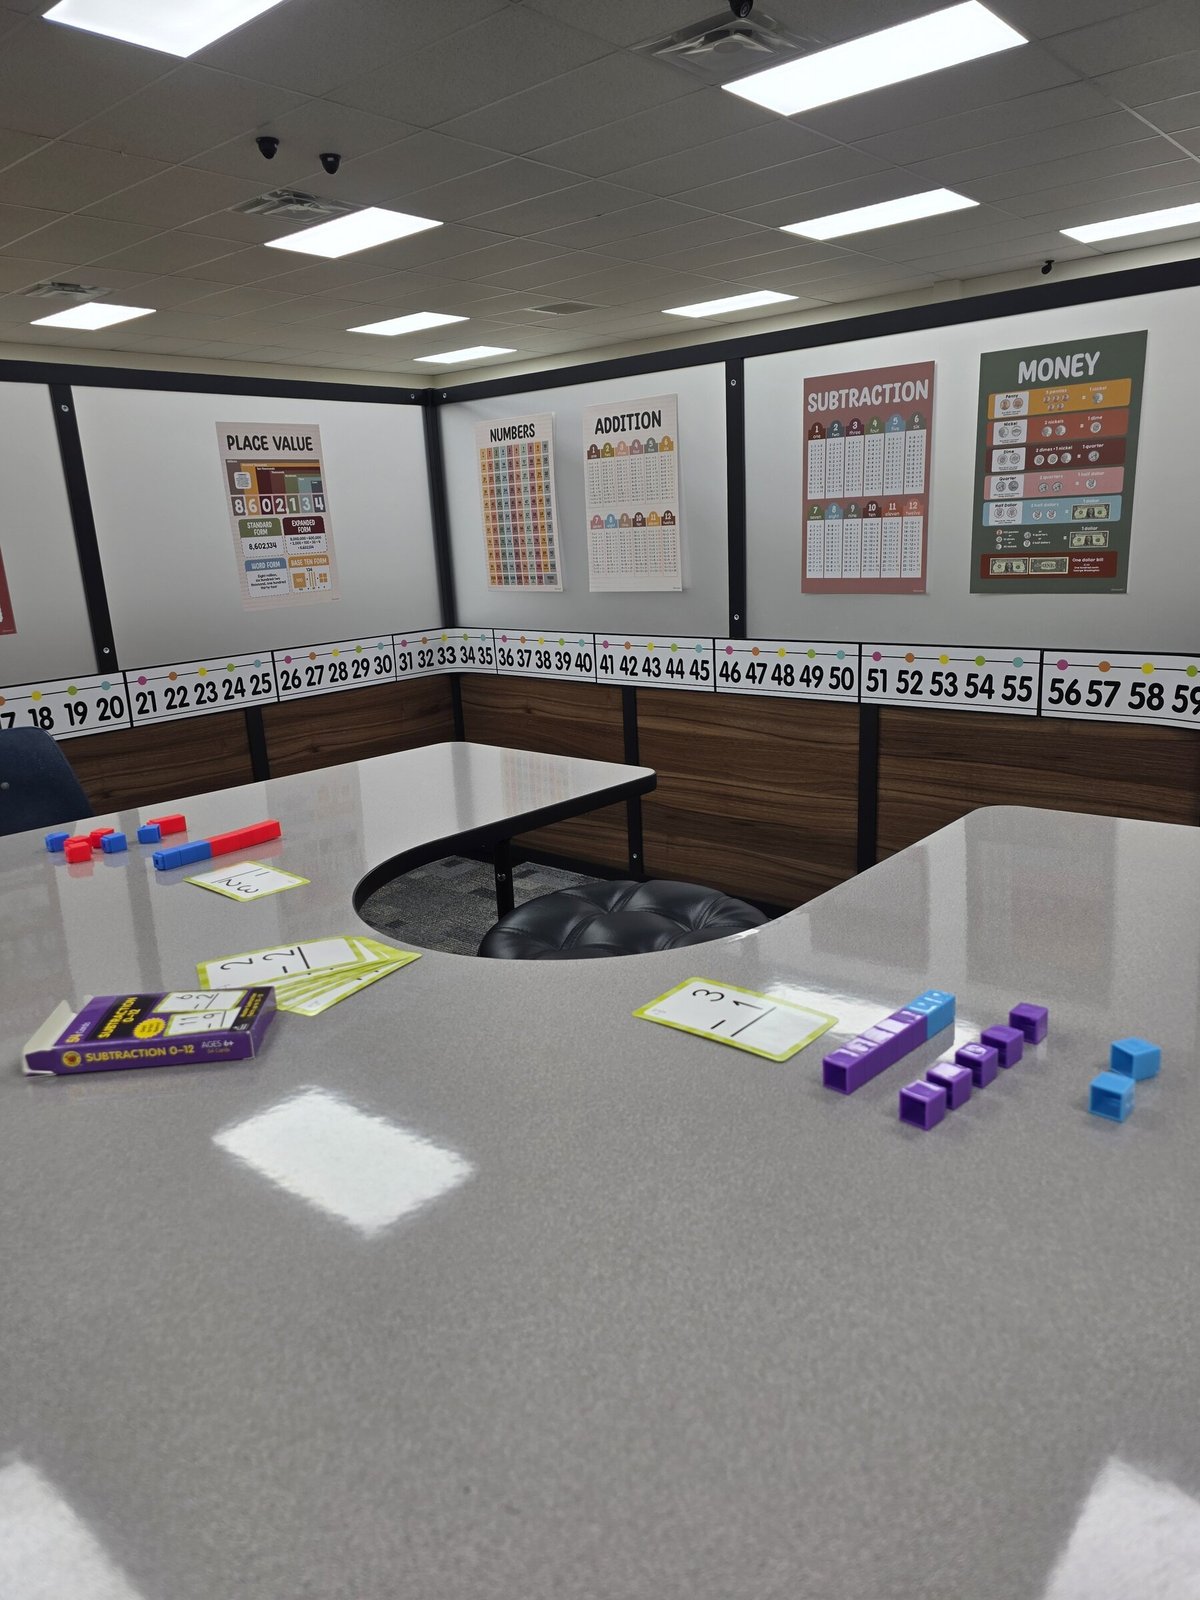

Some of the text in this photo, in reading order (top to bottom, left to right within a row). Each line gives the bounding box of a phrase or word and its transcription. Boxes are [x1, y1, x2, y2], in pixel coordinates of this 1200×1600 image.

[1017, 351, 1100, 384] MONEY
[807, 379, 929, 413] SUBTRACTION
[594, 410, 662, 435] ADDITION
[893, 417, 898, 425] 5
[914, 414, 919, 423] 6
[833, 423, 839, 431] 2
[852, 421, 858, 430] 3
[872, 419, 878, 428] 4
[489, 423, 535, 443] NUMBERS
[814, 425, 820, 433] 1
[226, 434, 314, 451] PLACE VALUE
[649, 440, 654, 448] 5
[591, 447, 596, 455] 1
[813, 506, 818, 514] 7
[831, 505, 837, 513] 8
[850, 504, 855, 513] 9
[868, 503, 877, 512] 10
[888, 502, 897, 511] 11
[908, 501, 918, 510] 12
[665, 512, 672, 520] 12
[247, 521, 272, 529] STANDARD
[291, 519, 315, 527] EXPANDED
[253, 528, 268, 536] FORM
[251, 560, 281, 569] WORD FORM
[399, 645, 493, 672] 31 32 33 34 35
[498, 647, 593, 673] 36 37 38 39 40
[599, 654, 710, 681] 41 42 43 44 45
[280, 654, 392, 691] 26 27 28 29 30
[719, 661, 854, 690] 46 47 48 49 50
[866, 668, 1033, 702] 51 52 53 54 55
[135, 672, 273, 715] 21 22 23 24 25
[1048, 678, 1200, 716] 56 57 58 59
[27, 706, 54, 731] 18
[63, 701, 88, 726] 19
[96, 695, 125, 722] 20
[237, 885, 259, 894] 3
[262, 949, 295, 961] 2
[220, 957, 253, 971] 2
[692, 988, 725, 1002] 3
[732, 1000, 763, 1010] 1
[97, 996, 138, 1039] SUBTRACTION
[179, 1016, 199, 1026] 11
[201, 1040, 222, 1048] AGES
[85, 1047, 166, 1062] SUBTRACTION
